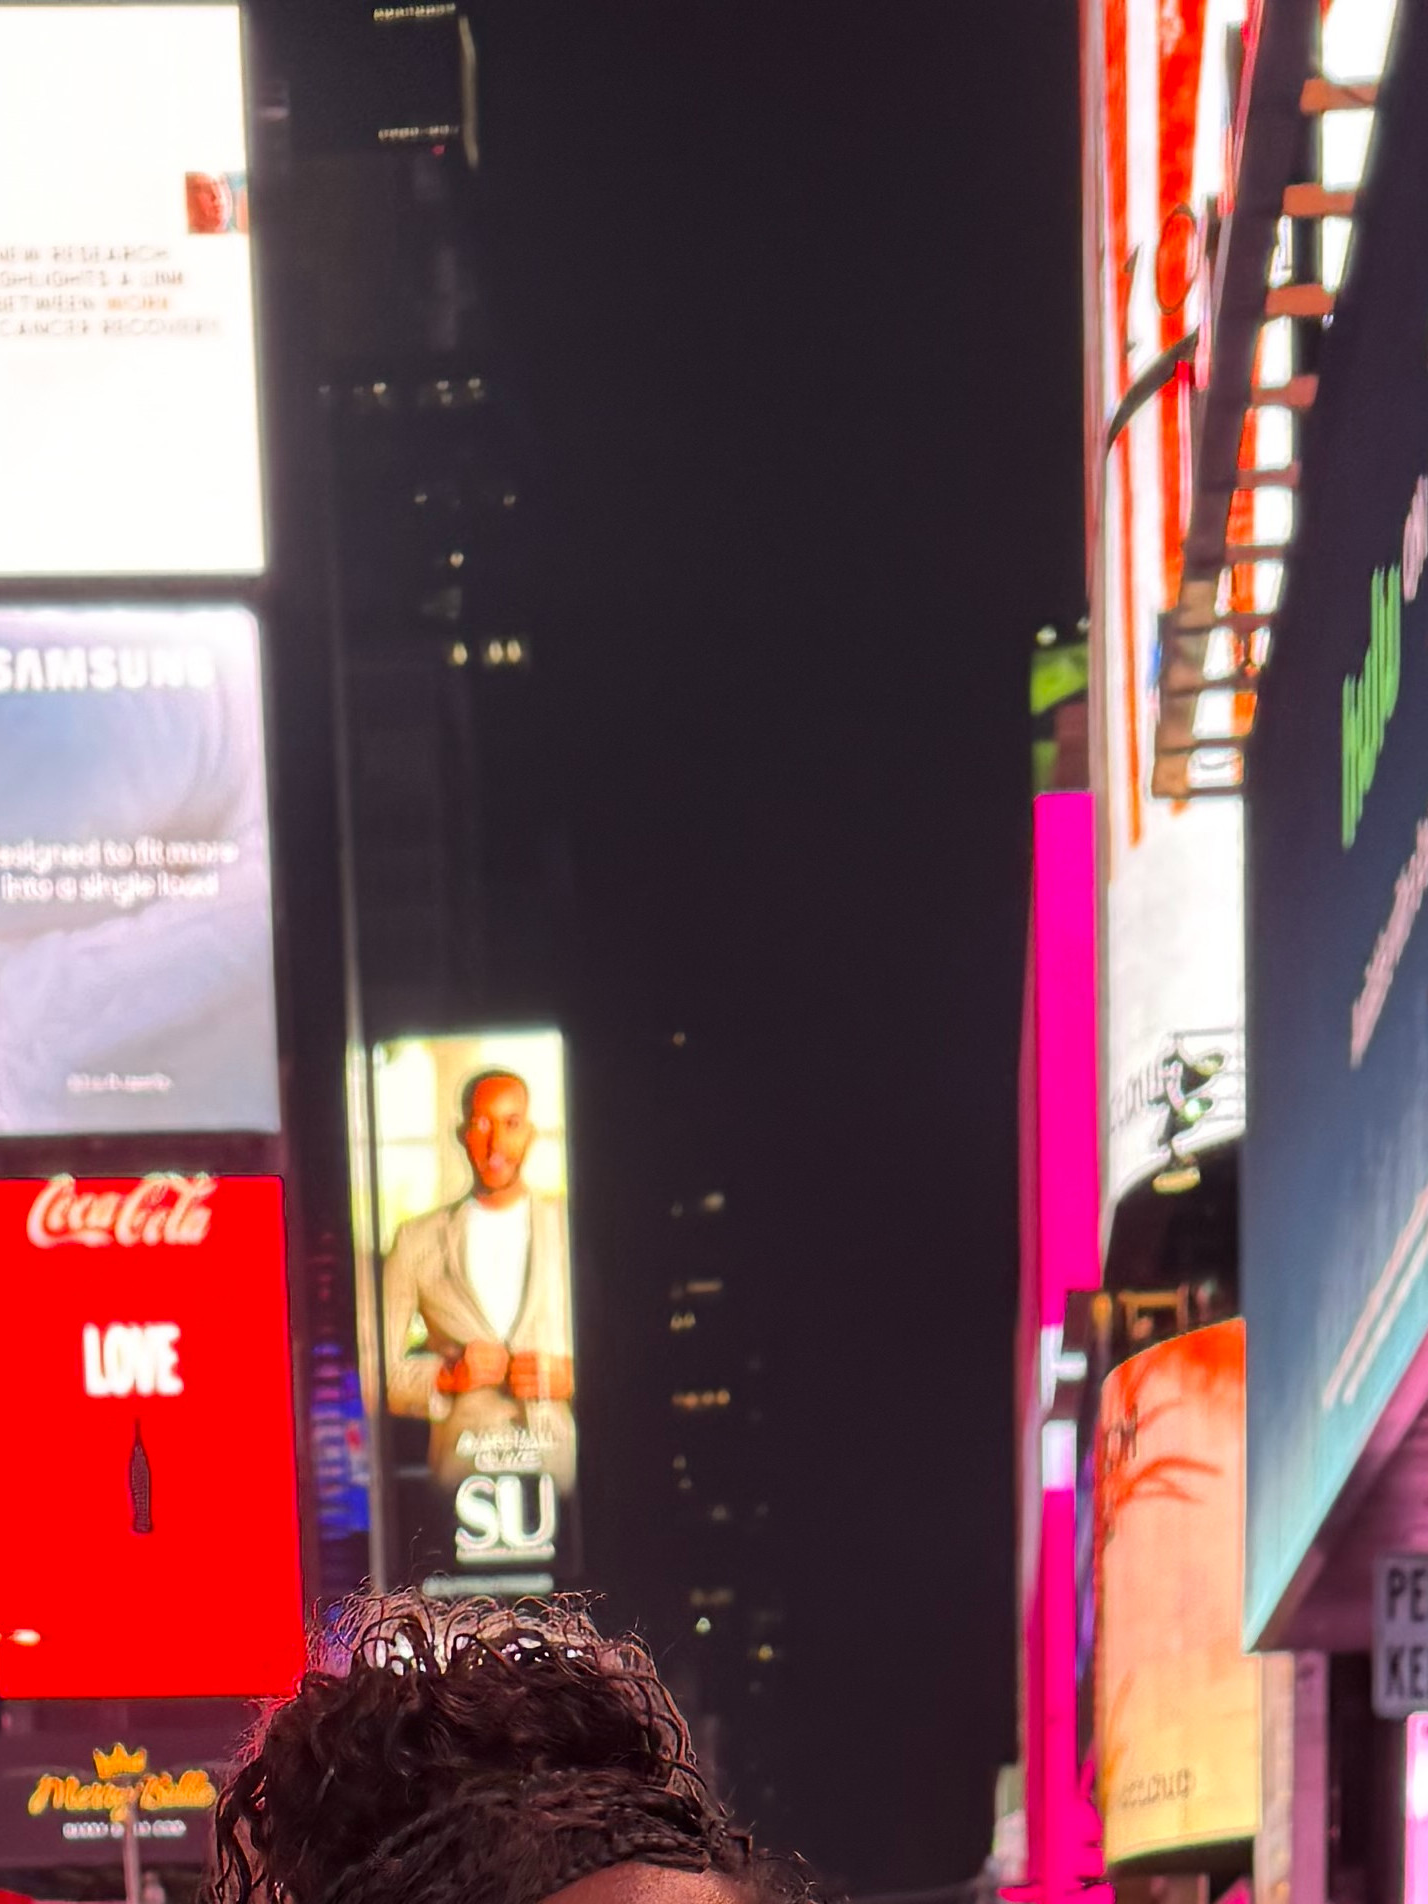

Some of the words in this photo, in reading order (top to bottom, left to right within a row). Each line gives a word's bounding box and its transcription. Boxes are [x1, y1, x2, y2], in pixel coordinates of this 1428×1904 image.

[103, 839, 134, 869] to
[166, 840, 241, 867] more
[83, 1321, 185, 1398] LOVE
